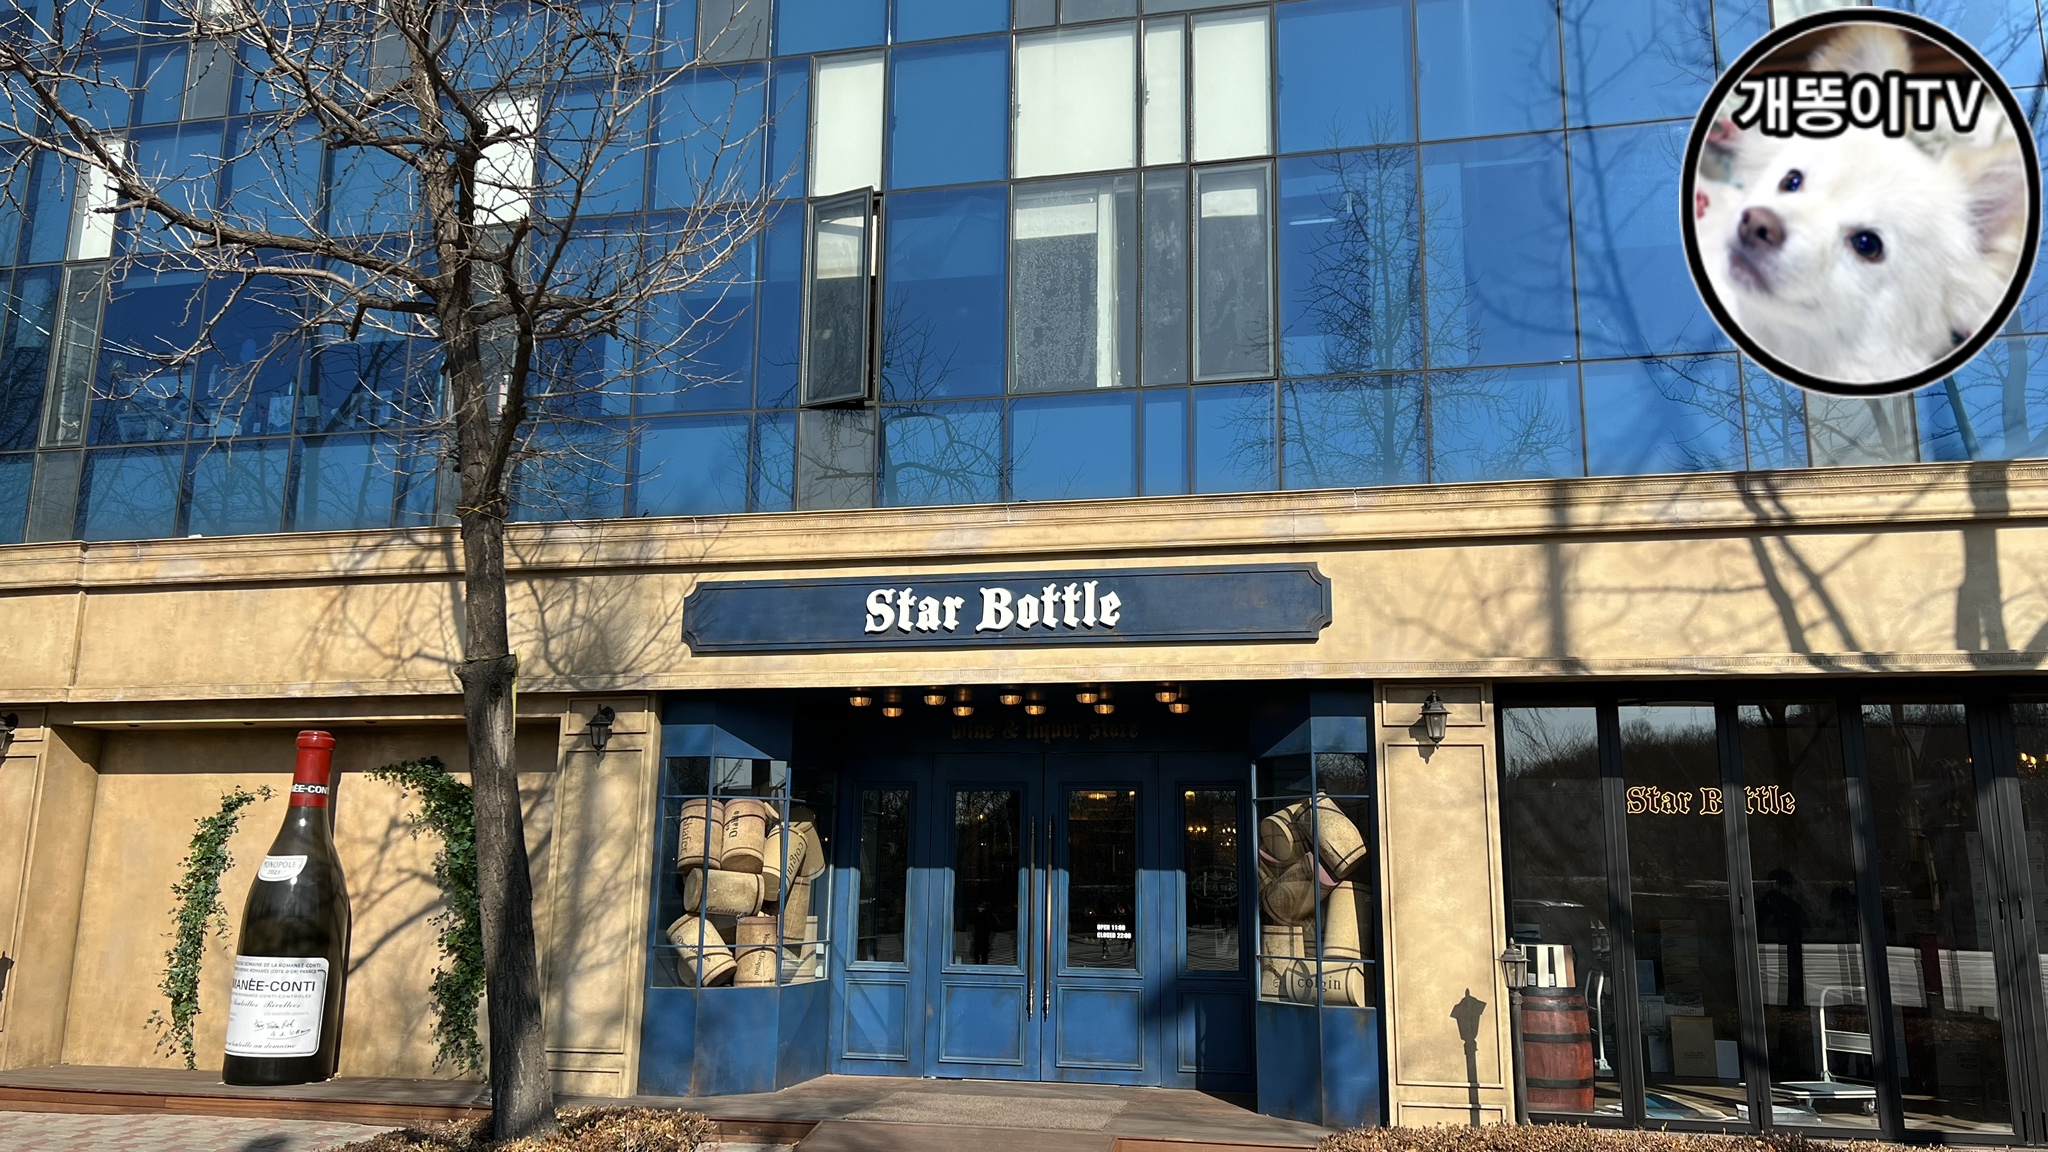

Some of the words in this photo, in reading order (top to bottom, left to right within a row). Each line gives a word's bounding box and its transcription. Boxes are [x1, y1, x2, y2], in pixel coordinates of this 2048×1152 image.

[864, 586, 965, 634] Star
[975, 580, 1123, 632] Bottle
[951, 720, 995, 740] wine
[1001, 720, 1021, 739] &
[1026, 718, 1082, 744] liquor
[1088, 720, 1139, 740] store
[1626, 785, 1693, 814] Star
[1699, 785, 1796, 815] Bttle
